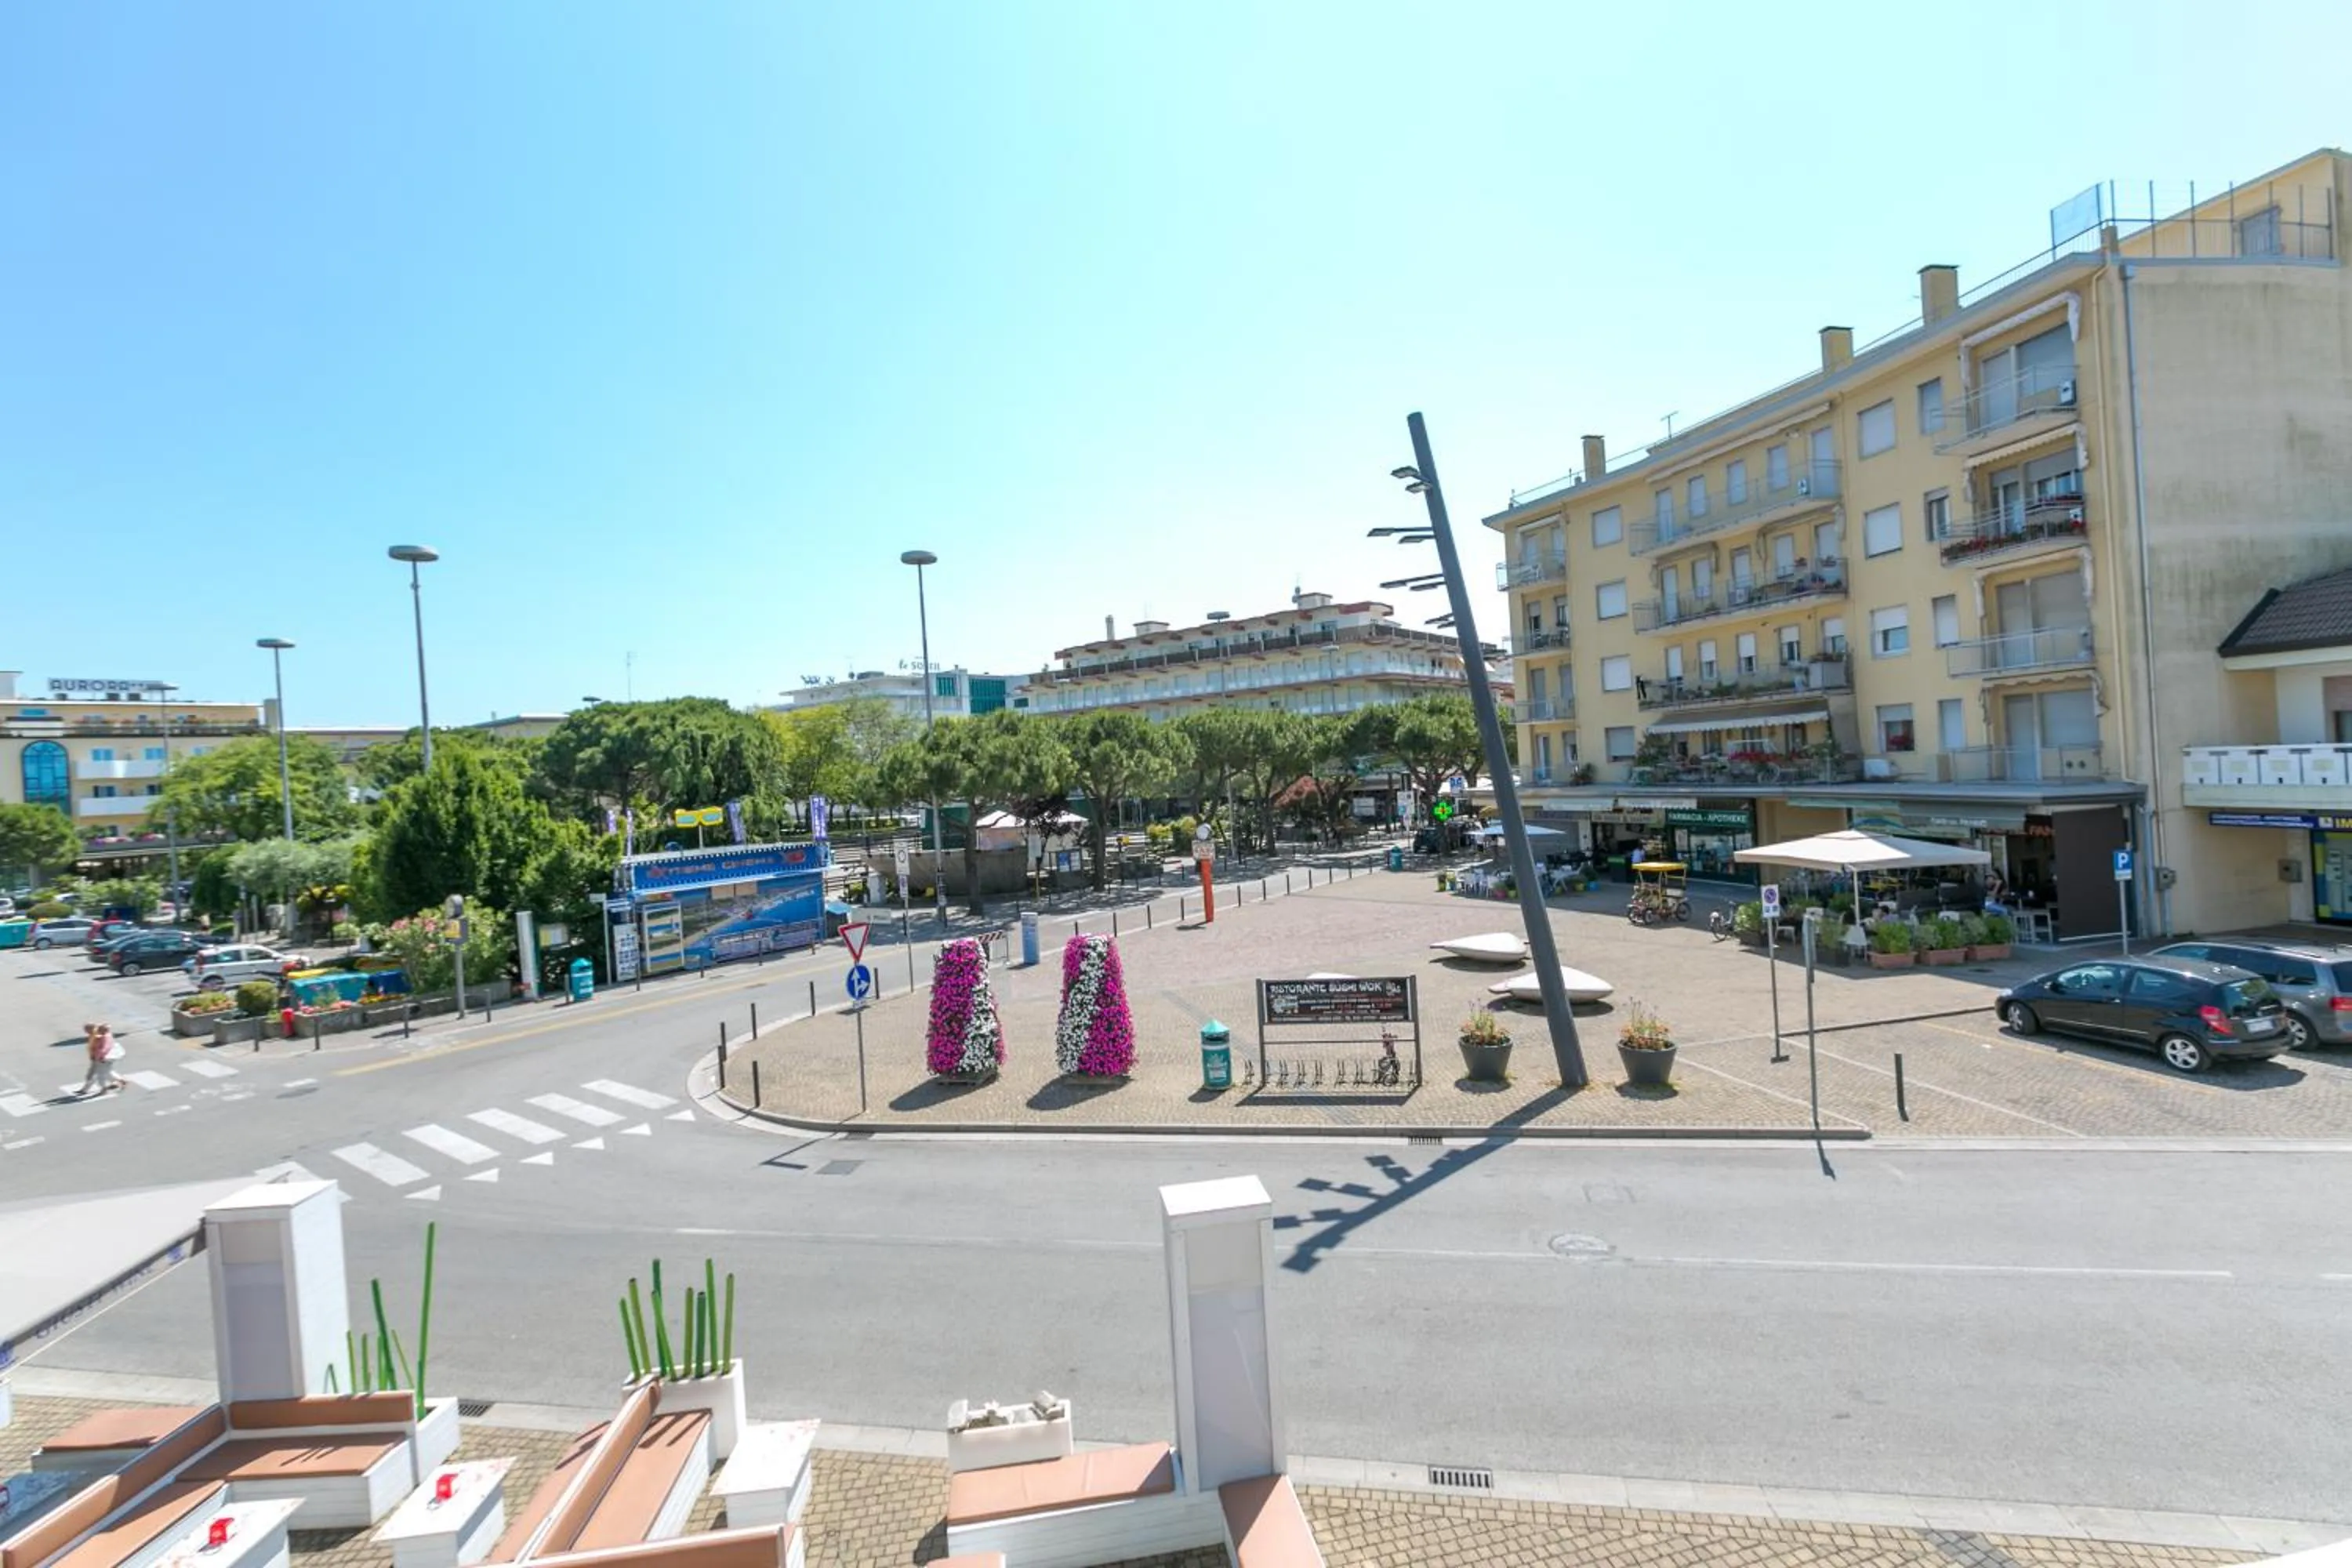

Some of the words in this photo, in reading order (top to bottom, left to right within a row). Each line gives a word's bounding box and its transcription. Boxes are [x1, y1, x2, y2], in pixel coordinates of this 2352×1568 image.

[50, 680, 129, 691] AURORA
[1668, 813, 1702, 822] FARMACIA
[1708, 814, 1747, 823] APOTHEKE
[2118, 852, 2129, 869] P
[1269, 984, 1327, 994] RISTORANTE
[1329, 982, 1357, 993] SUSHI
[1359, 982, 1382, 992] WOK
